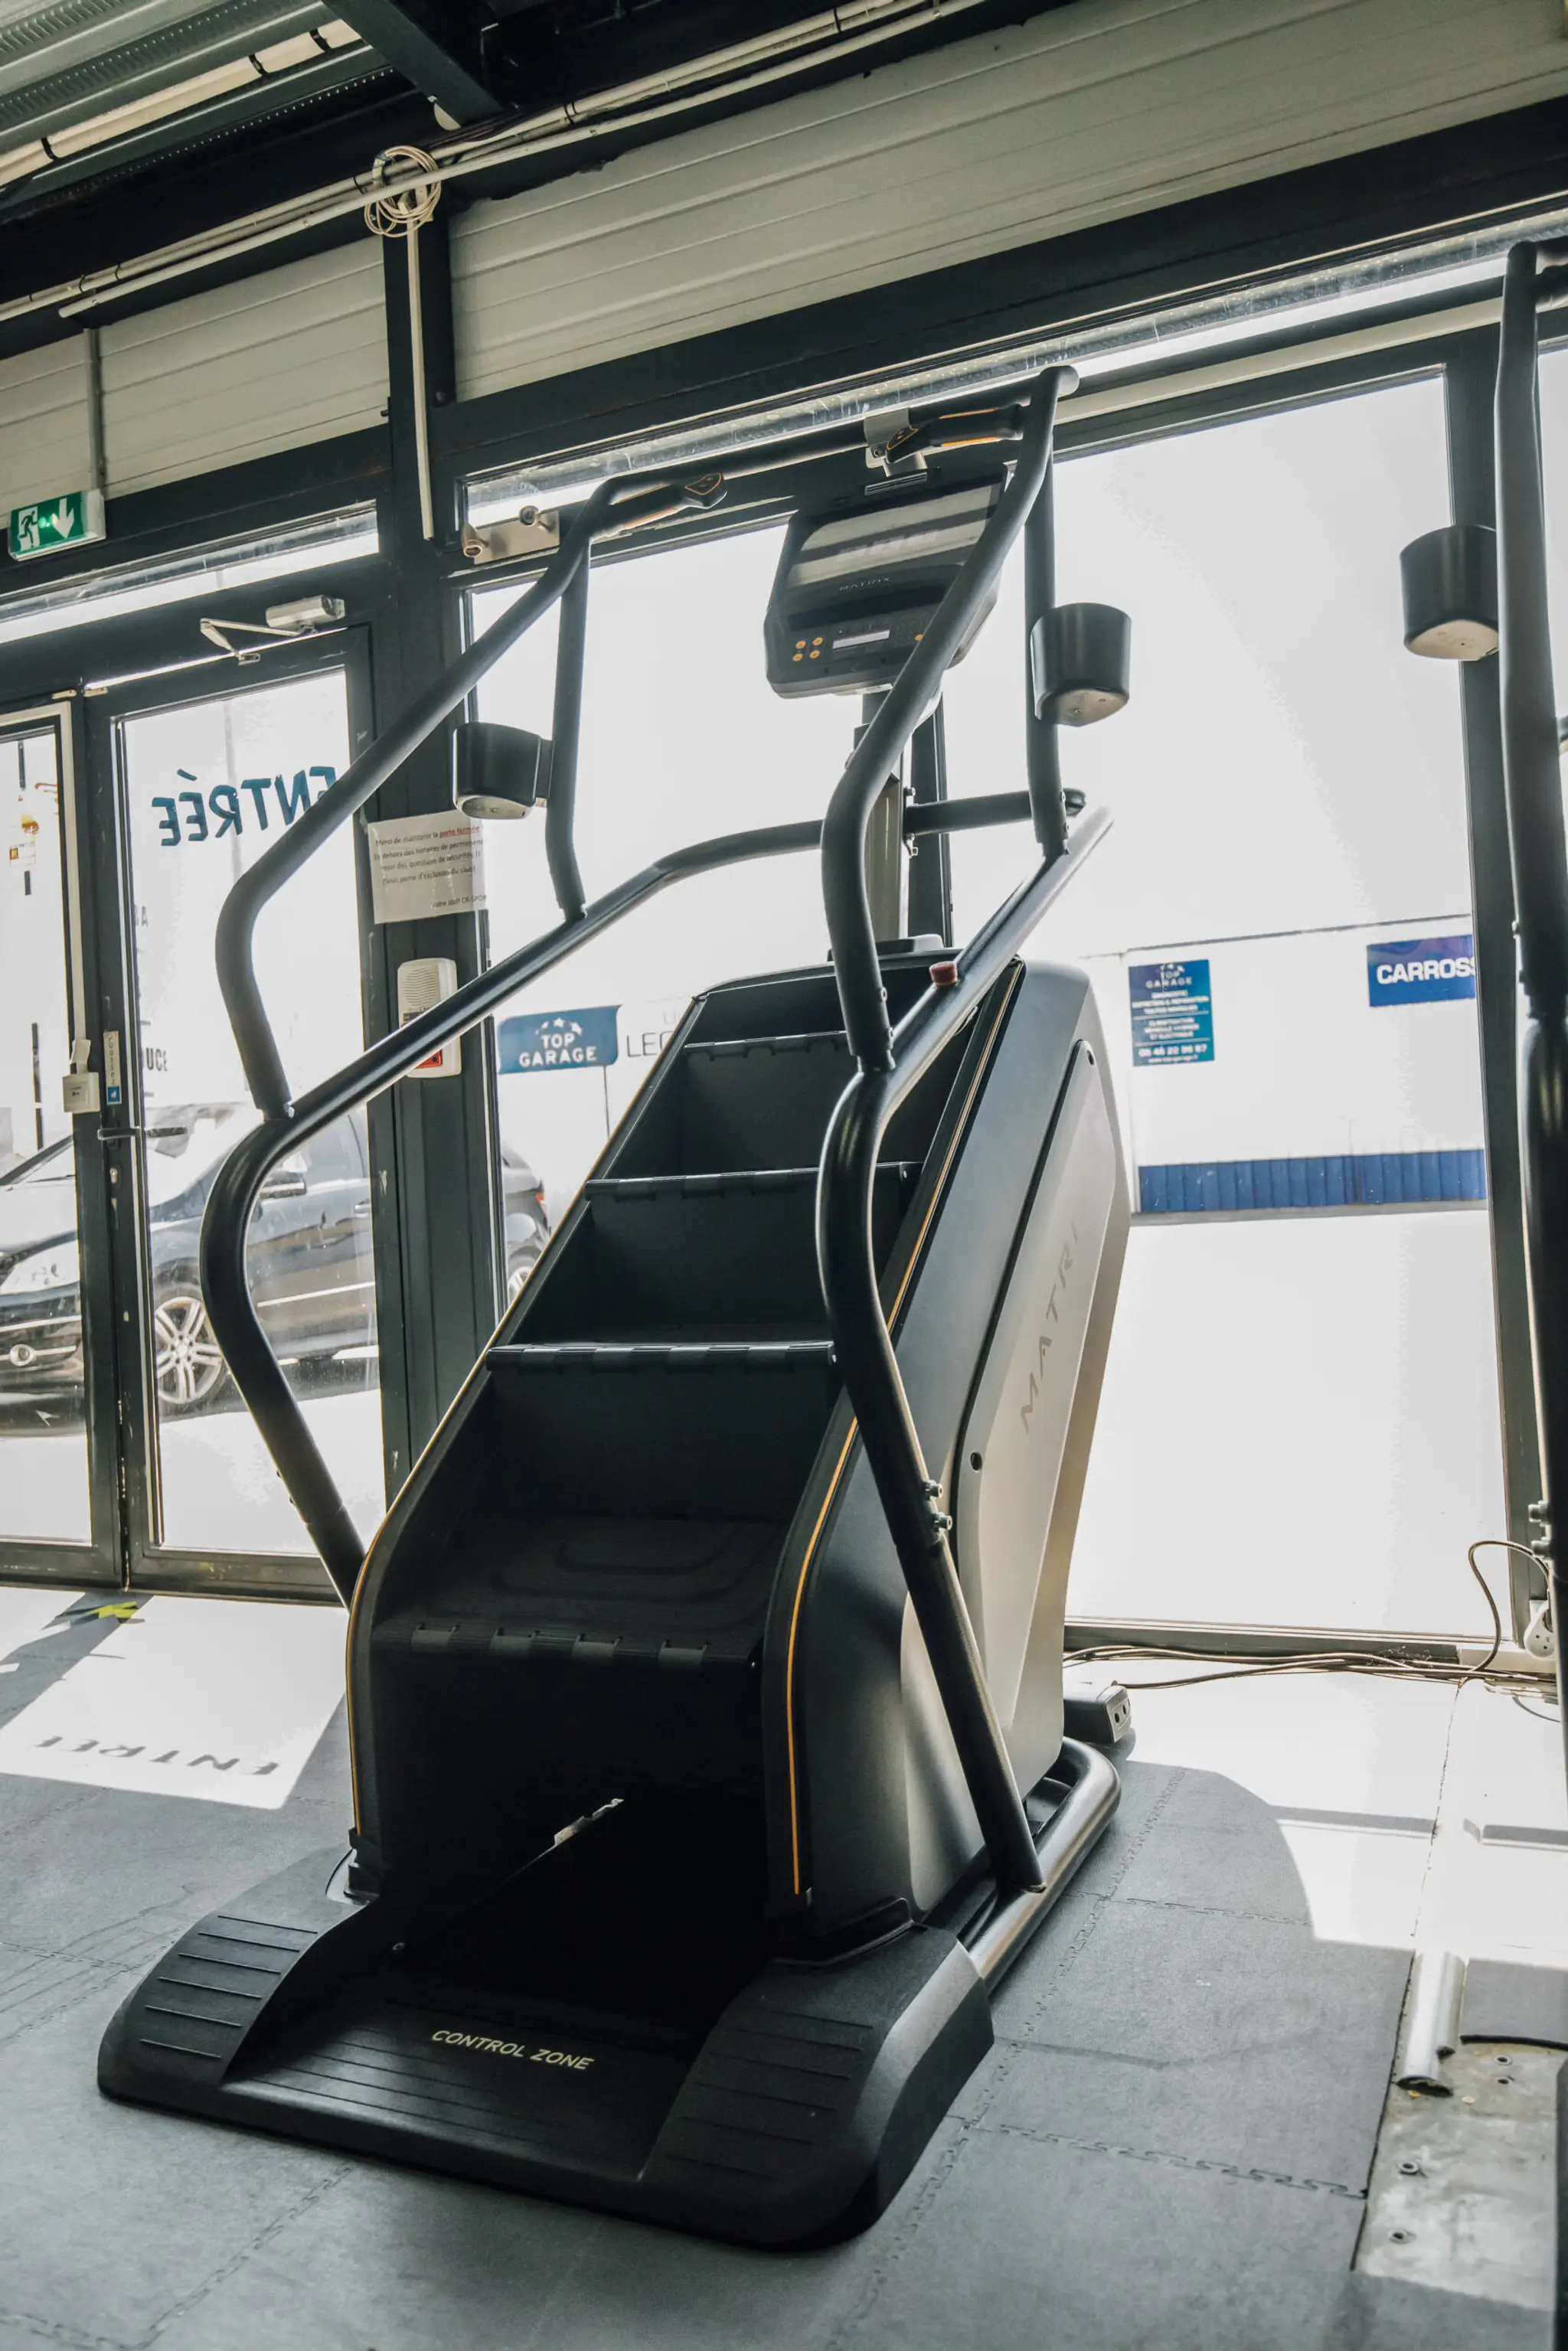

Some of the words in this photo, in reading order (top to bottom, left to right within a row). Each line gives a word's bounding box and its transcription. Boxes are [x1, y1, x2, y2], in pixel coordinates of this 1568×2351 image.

[839, 576, 891, 592] MATRIX
[1376, 955, 1475, 985] CARROS
[1145, 976, 1193, 989] GARAGE
[541, 1032, 575, 1050] TOP
[518, 1046, 597, 1067] GARAGE
[430, 2029, 528, 2058] CONTROL
[530, 2049, 596, 2071] ZONE
